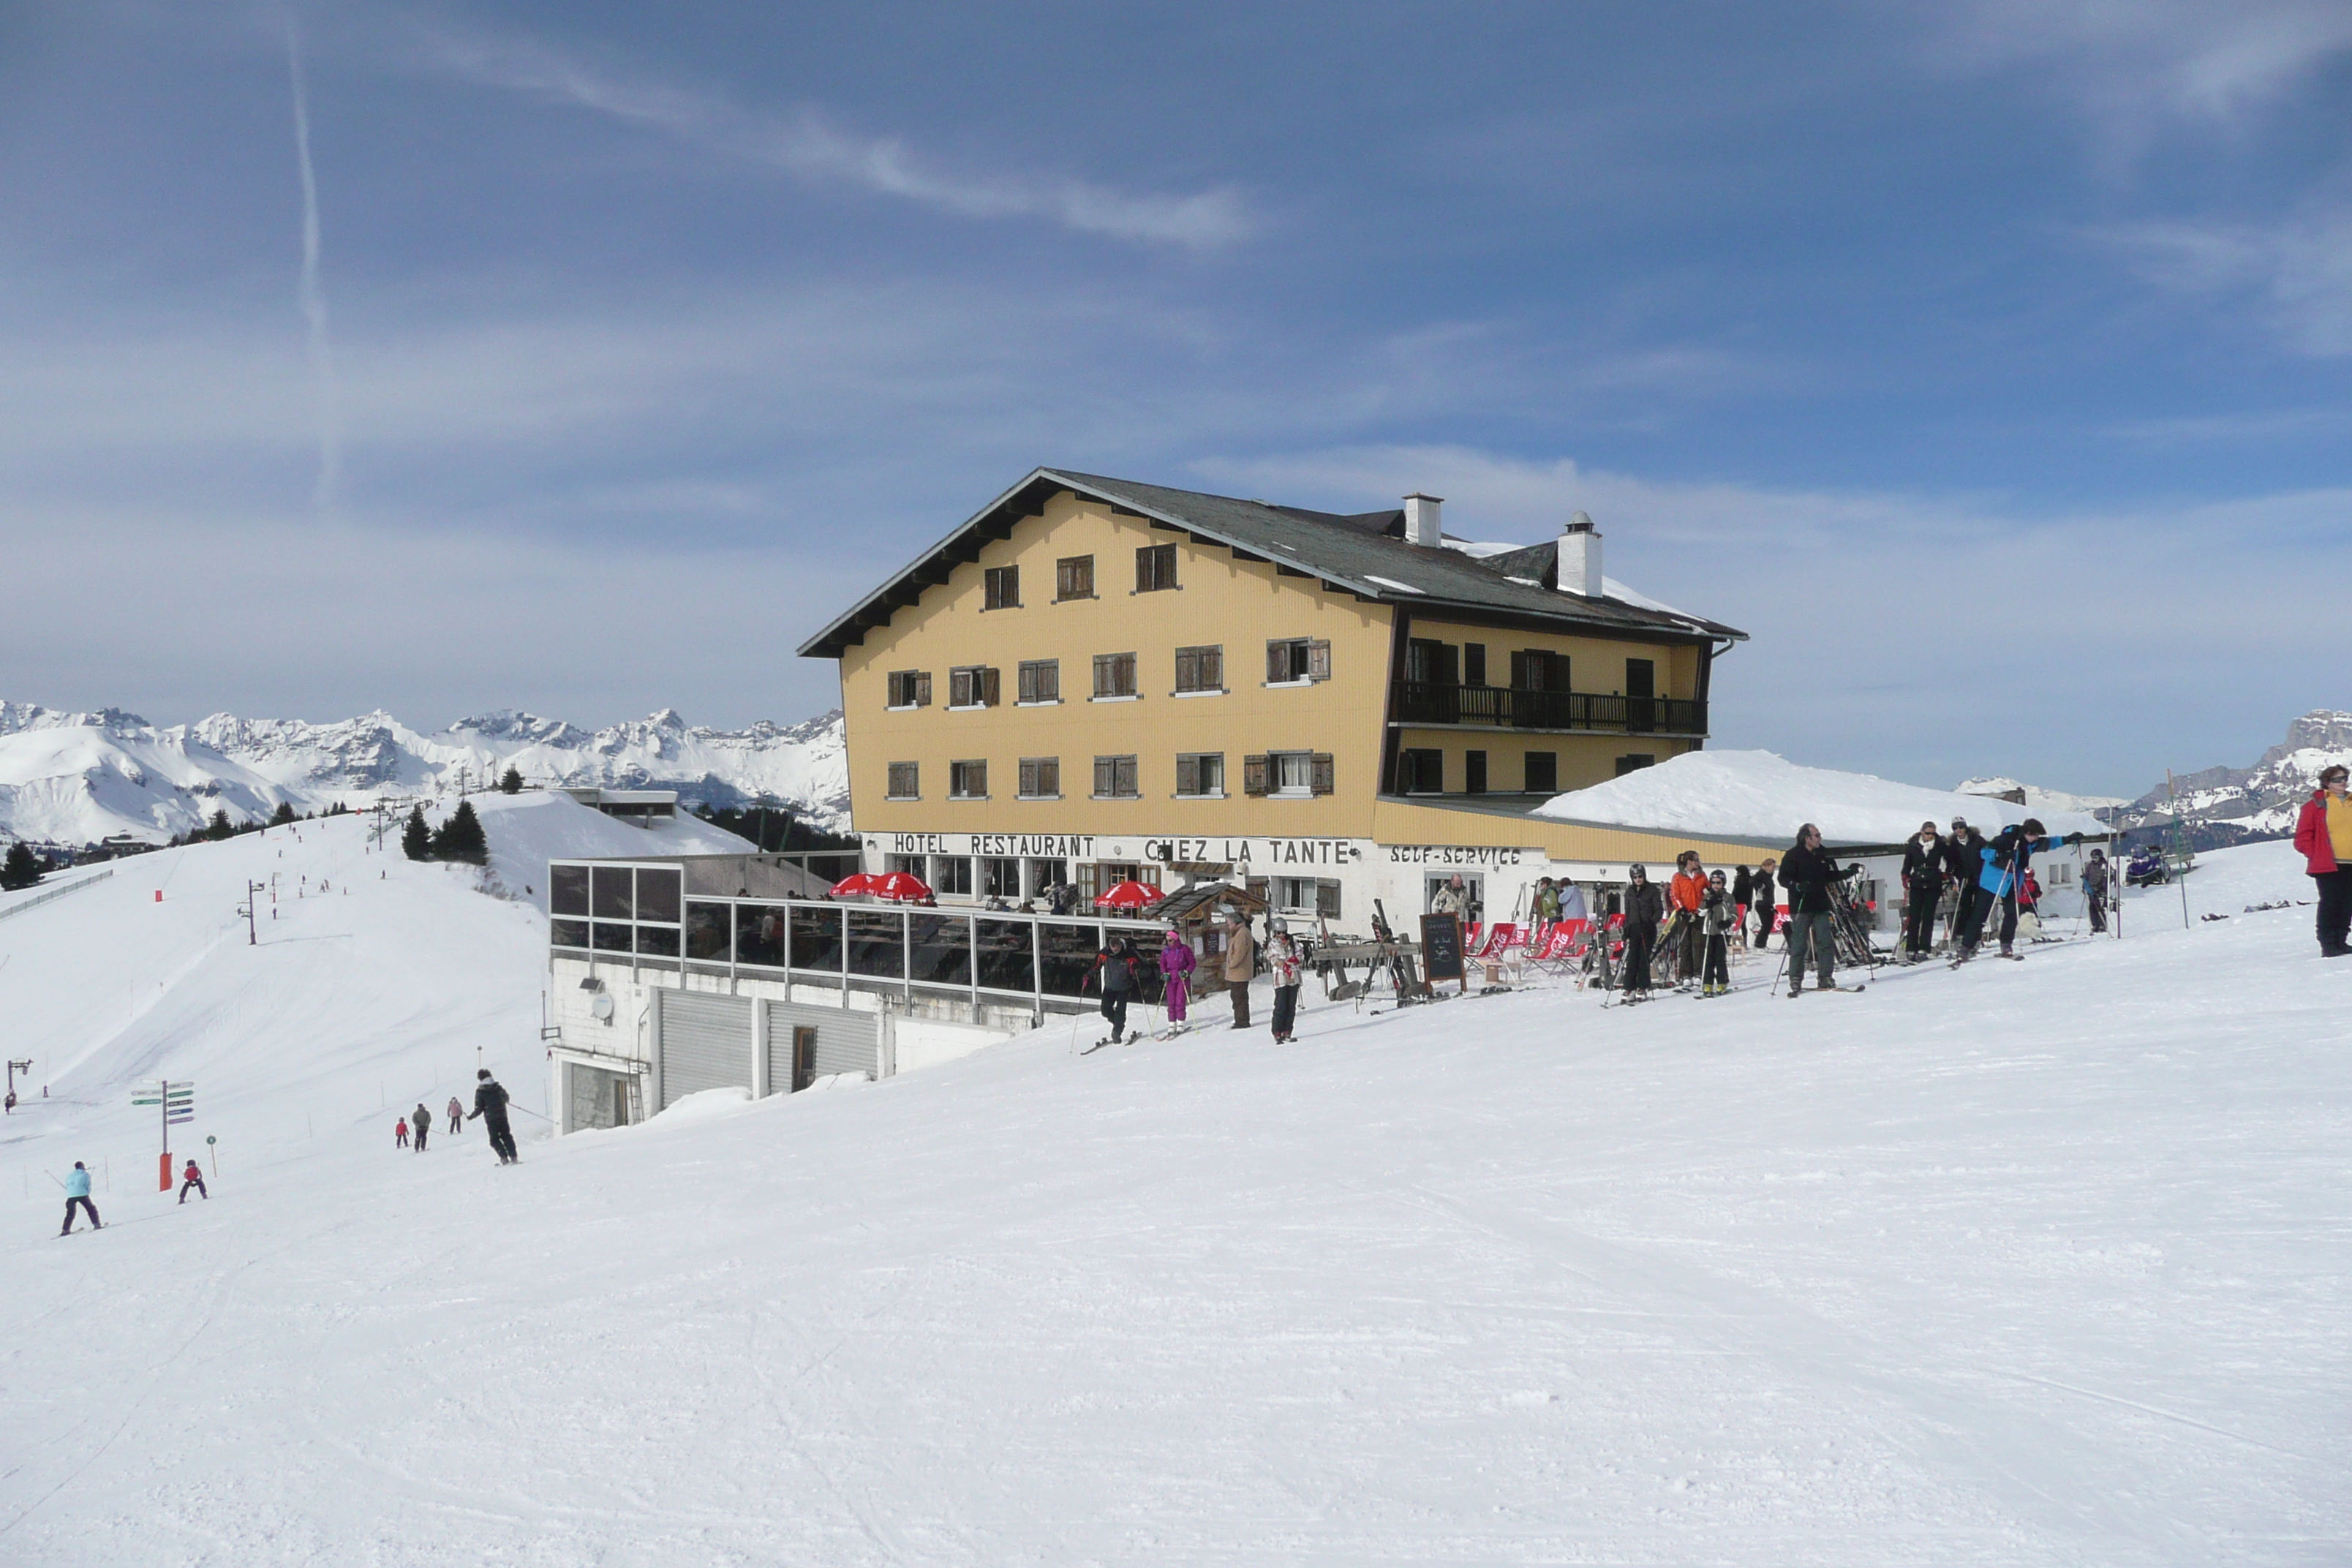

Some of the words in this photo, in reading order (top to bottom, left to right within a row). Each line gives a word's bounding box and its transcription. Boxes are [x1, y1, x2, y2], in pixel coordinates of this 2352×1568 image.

[895, 834, 948, 853] HOTEL
[970, 835, 1094, 856] RESTAURANT
[1145, 840, 1207, 862] CEZ
[1225, 840, 1252, 862] LA
[1269, 840, 1349, 864] TANTE
[1390, 845, 1521, 865] SELF-SERVICE
